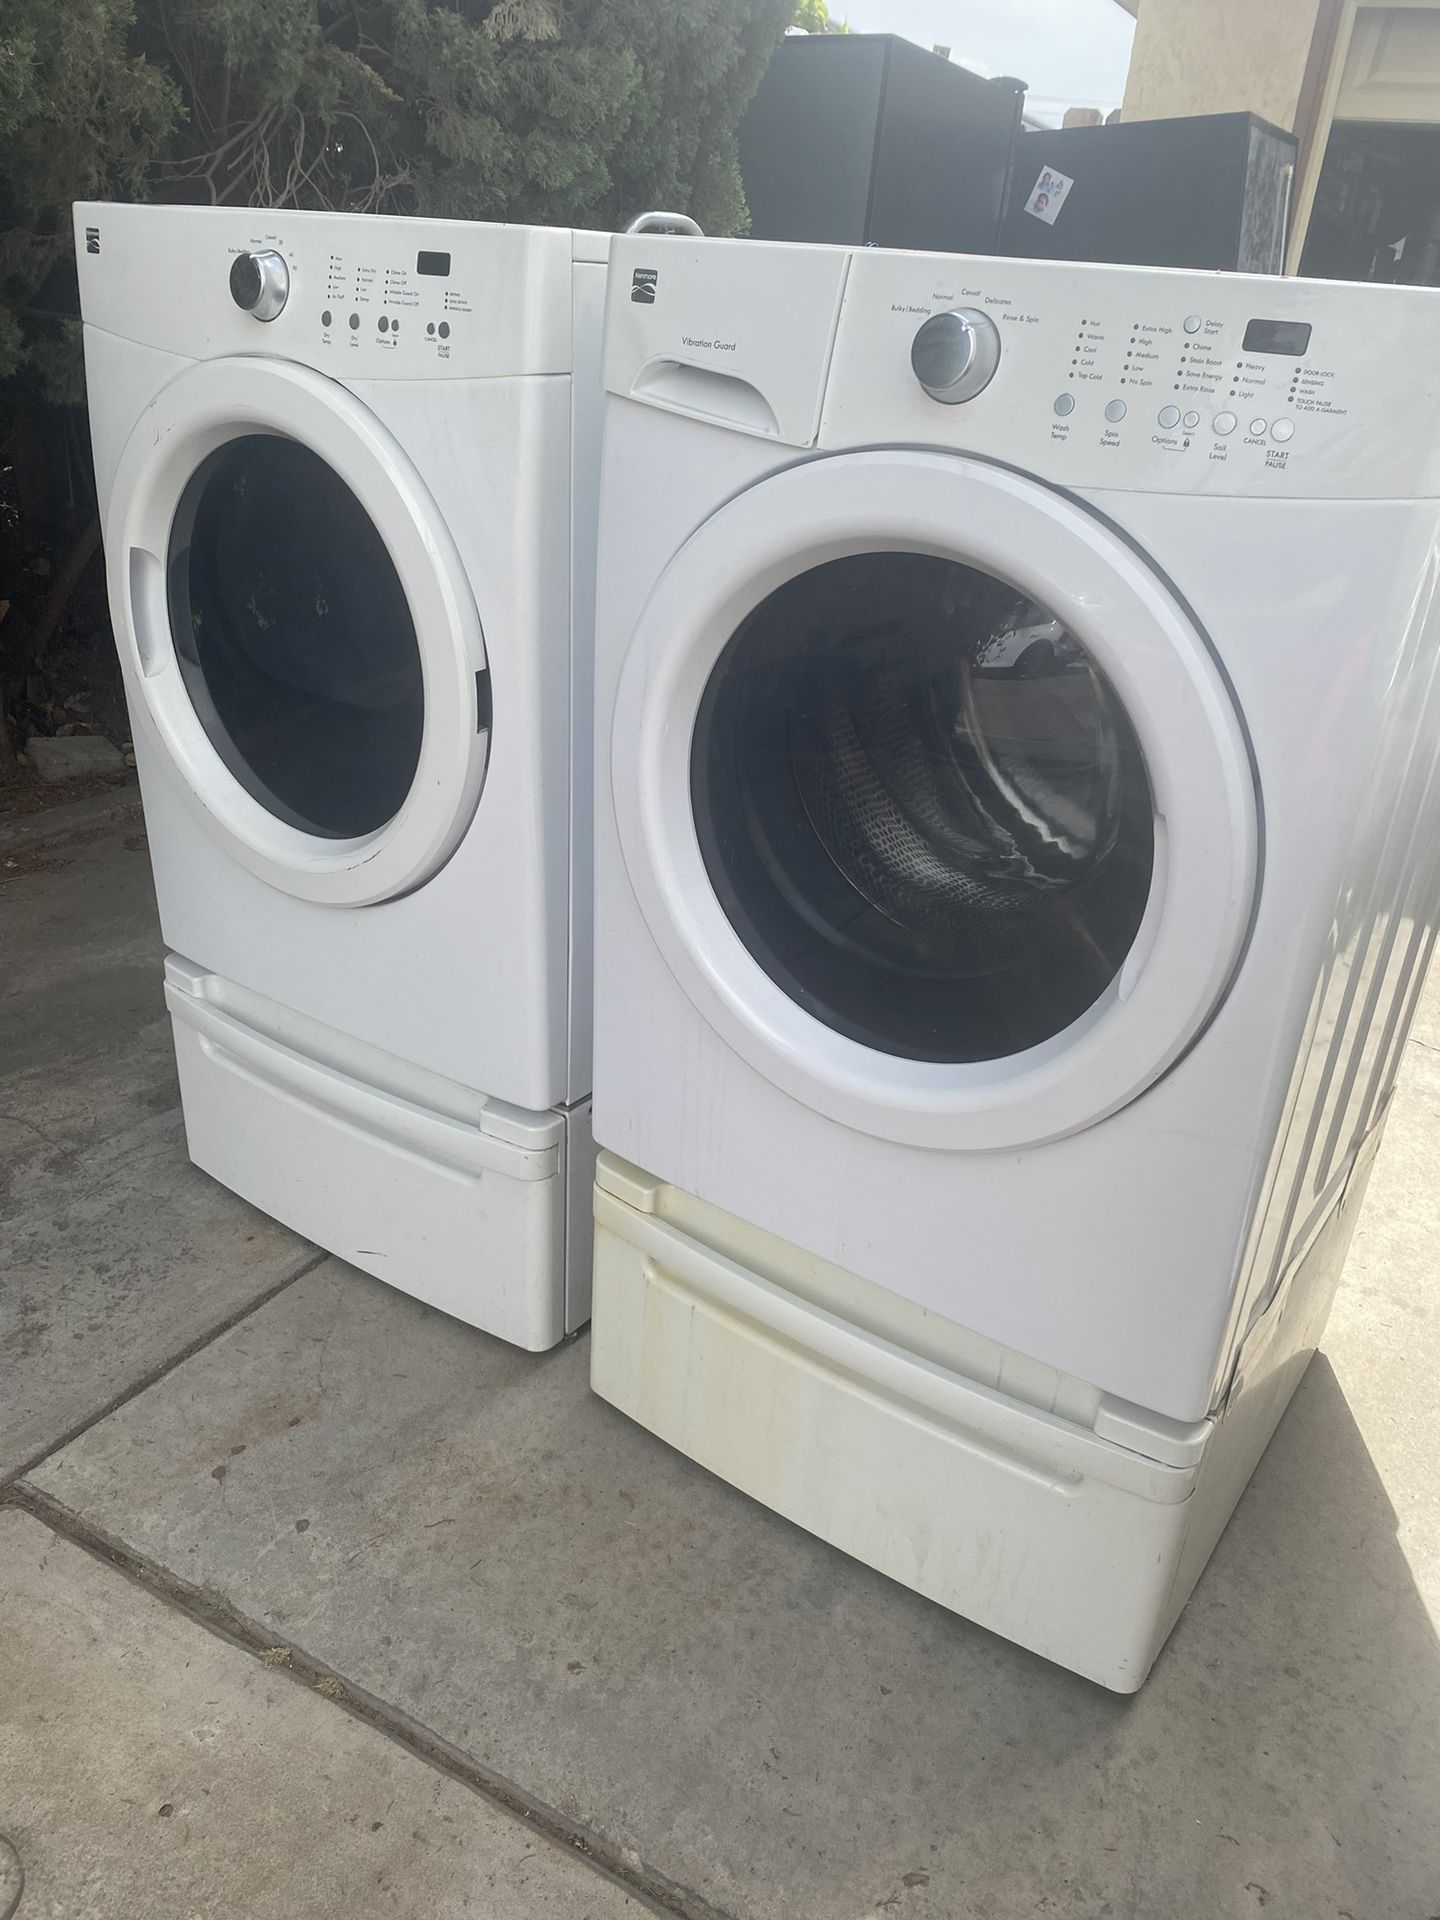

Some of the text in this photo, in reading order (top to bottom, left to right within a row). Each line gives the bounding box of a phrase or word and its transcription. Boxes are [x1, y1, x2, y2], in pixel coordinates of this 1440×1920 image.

[635, 272, 657, 280] Kenmore
[961, 288, 981, 296] Casual
[932, 293, 955, 301] Normal
[985, 296, 1011, 305] Delicates
[1002, 313, 1018, 321] Rinse
[1026, 315, 1040, 324] Spin
[1206, 320, 1224, 328] Delay
[1142, 325, 1172, 335] Extra High
[682, 337, 736, 351] Vibration Guard
[1138, 338, 1152, 346] High
[1192, 343, 1212, 351] Chime
[1135, 351, 1159, 360] Medium
[1246, 362, 1266, 372] Heavy
[1089, 373, 1103, 381] Cold
[1185, 370, 1223, 381] Save Energy
[1139, 379, 1152, 387] Spin
[1242, 377, 1266, 385] Normal
[1182, 384, 1198, 392] Extra
[1238, 391, 1254, 399] Light
[1052, 423, 1070, 432] Wash
[1051, 431, 1067, 441] Temp
[1104, 429, 1119, 438] Spin
[1099, 437, 1120, 447] Speed
[1151, 435, 1178, 445] Options
[1243, 437, 1266, 446] CANCEL
[1214, 443, 1227, 452] Soil
[1209, 452, 1227, 461] Level
[1266, 449, 1289, 460] START
[1264, 460, 1286, 470] PAUSE
